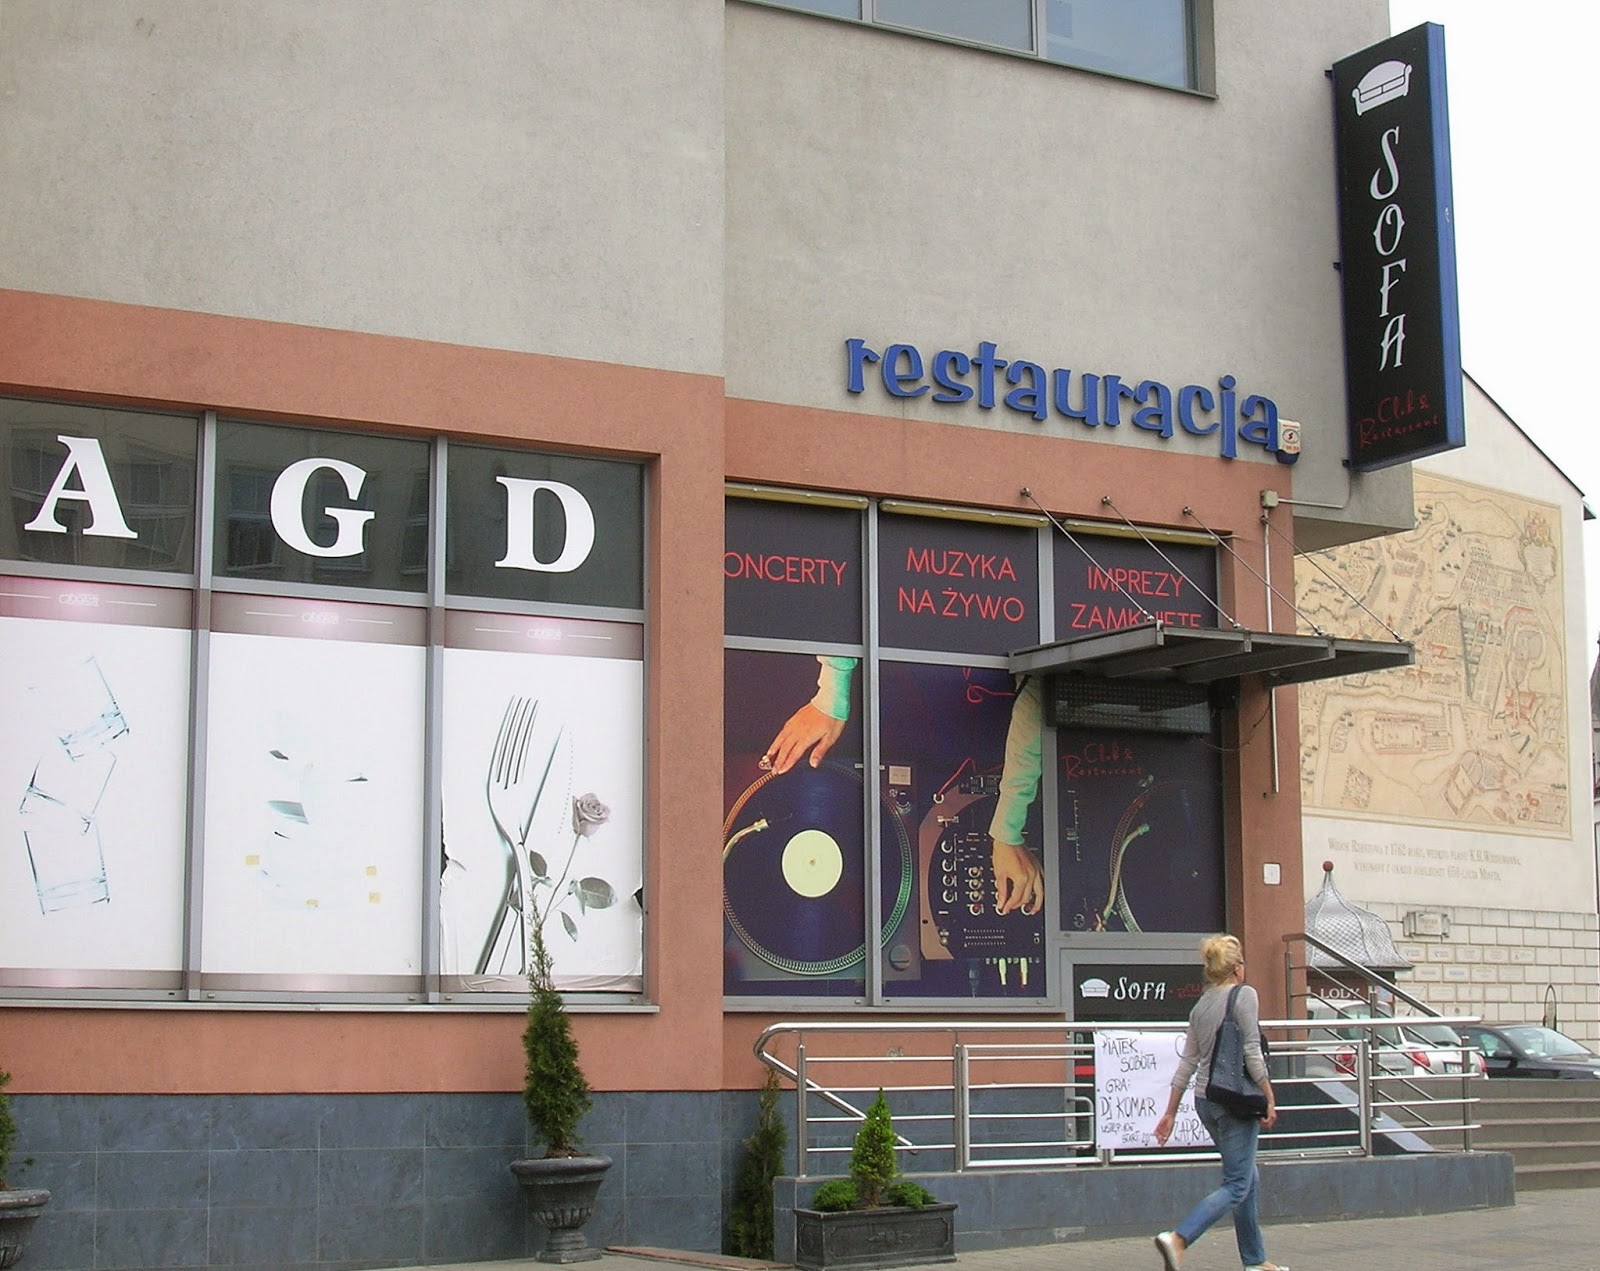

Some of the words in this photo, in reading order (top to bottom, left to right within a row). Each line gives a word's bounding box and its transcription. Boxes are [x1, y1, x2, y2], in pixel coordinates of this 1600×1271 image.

[1369, 126, 1406, 373] SOFA
[844, 337, 1279, 460] restauracja
[906, 547, 1017, 581] MUZYKA
[1087, 566, 1184, 598] IMPREZY
[899, 586, 937, 615] NA
[942, 586, 1025, 622] ŻYWO
[1114, 976, 1166, 1000] SOFA
